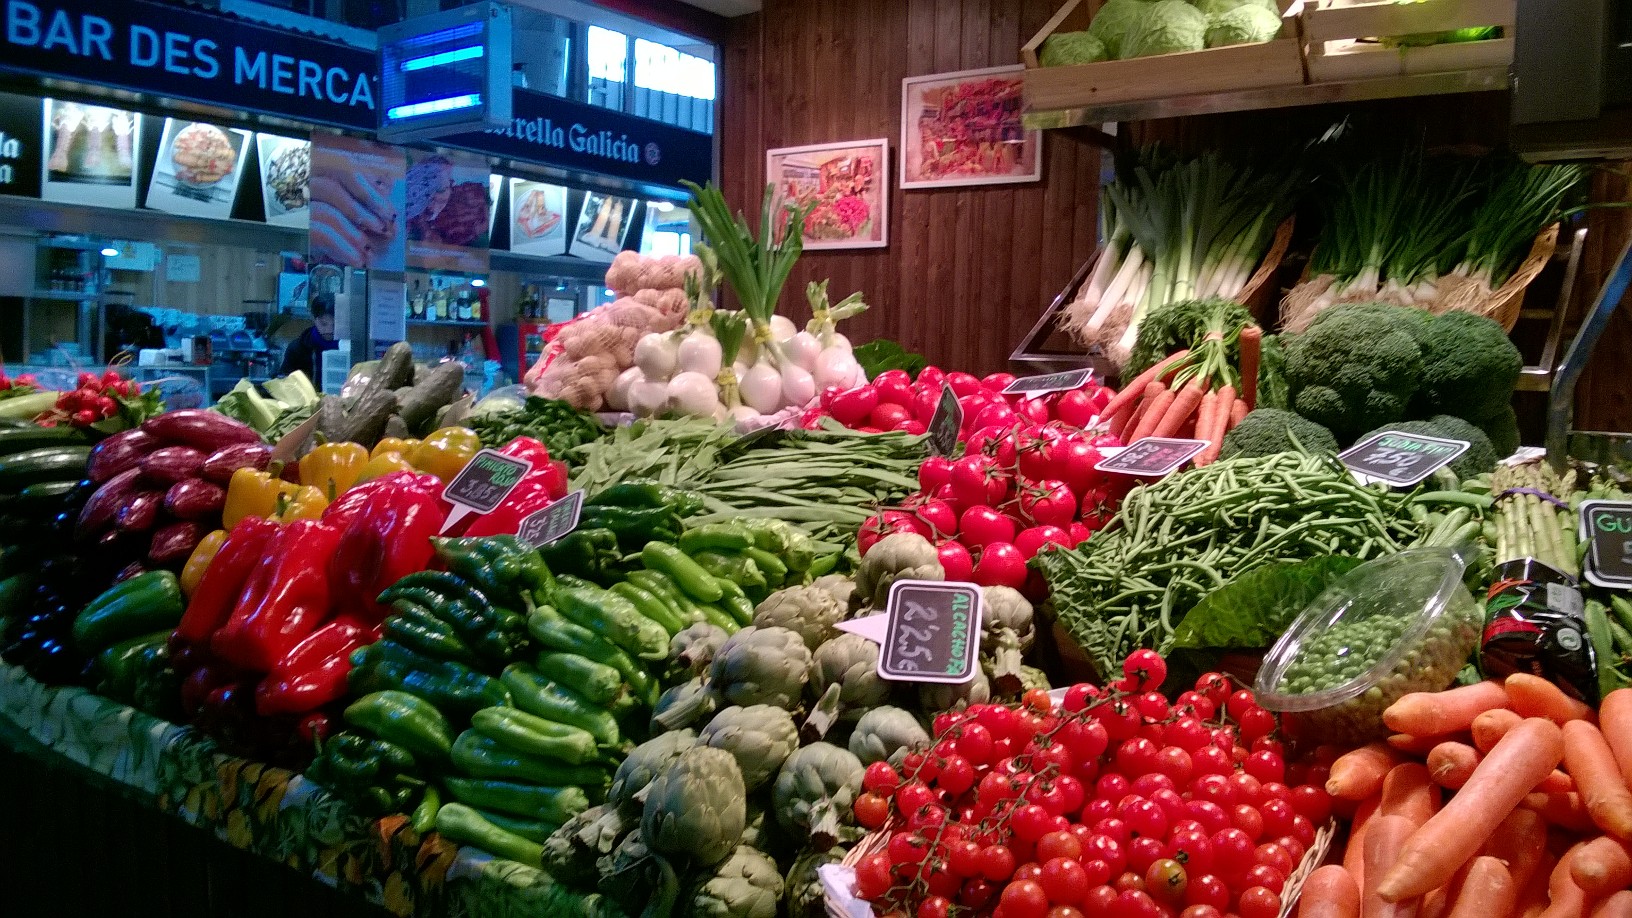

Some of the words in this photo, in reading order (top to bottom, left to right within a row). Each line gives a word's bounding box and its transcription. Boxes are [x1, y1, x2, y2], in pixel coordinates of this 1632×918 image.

[7, 1, 113, 61] BAR
[130, 24, 220, 79] DES
[234, 46, 379, 110] MERCA
[569, 122, 640, 164] Galicia
